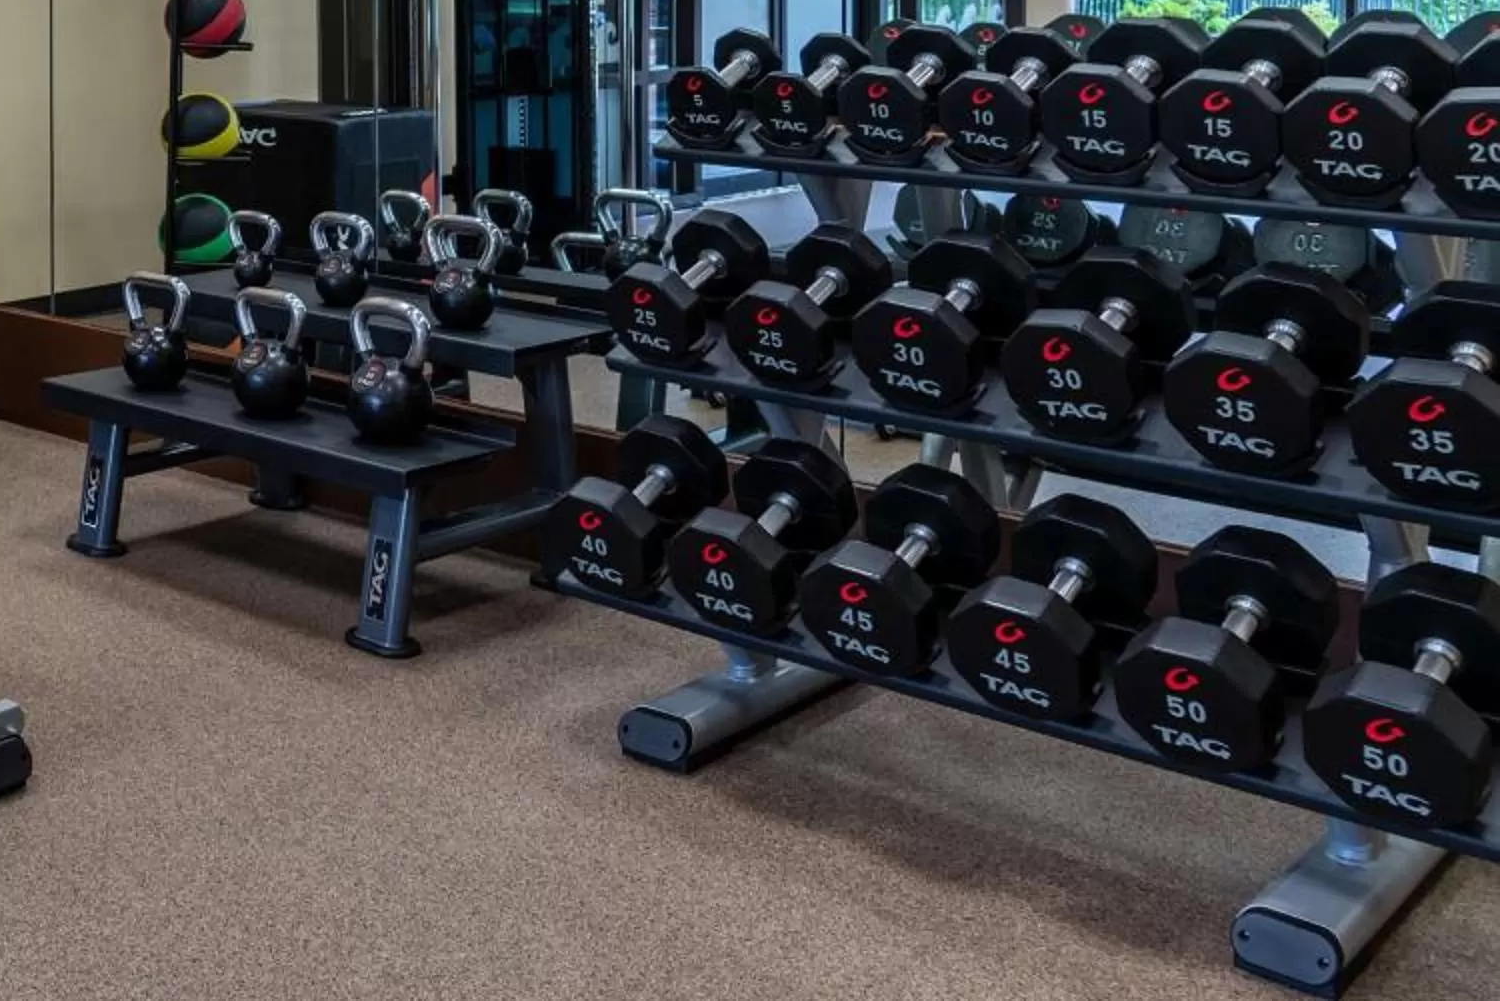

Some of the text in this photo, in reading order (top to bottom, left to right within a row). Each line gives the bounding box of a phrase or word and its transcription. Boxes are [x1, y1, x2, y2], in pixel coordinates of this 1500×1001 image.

[694, 95, 702, 106] 5
[782, 100, 791, 113] 5
[870, 103, 888, 117] 10
[686, 114, 720, 124] TAG
[771, 119, 807, 133] TAG
[973, 110, 993, 125] 10
[1082, 110, 1106, 128] 15
[1204, 118, 1231, 137] 15
[858, 125, 903, 141] TAG
[960, 131, 1008, 149] TAG
[1329, 131, 1362, 150] 20
[1067, 136, 1124, 155] TAG
[1188, 145, 1250, 166] TAG
[1314, 159, 1382, 179] TAG
[1456, 176, 1500, 190] TA
[635, 309, 656, 326] 25
[627, 330, 671, 353] TAG
[758, 329, 782, 347] 25
[749, 351, 798, 374] TAG
[894, 343, 924, 365] 30
[880, 368, 942, 397] TAG
[1047, 368, 1081, 389] 30
[1039, 401, 1107, 420] TAG
[1217, 397, 1254, 421] 35
[1198, 425, 1276, 458] TAG
[1410, 429, 1453, 453] 35
[1393, 462, 1479, 489] TAG
[581, 535, 607, 557] 40
[571, 557, 623, 586] TAG
[707, 569, 733, 590] 40
[696, 593, 753, 622] TAG
[840, 608, 874, 632] 45
[827, 630, 890, 664] TAG
[996, 649, 1030, 673] 45
[980, 673, 1050, 708] TAG
[1167, 695, 1206, 722] 50
[1152, 724, 1232, 760] TAG
[1364, 745, 1407, 776] 50
[1340, 773, 1431, 817] TAG
